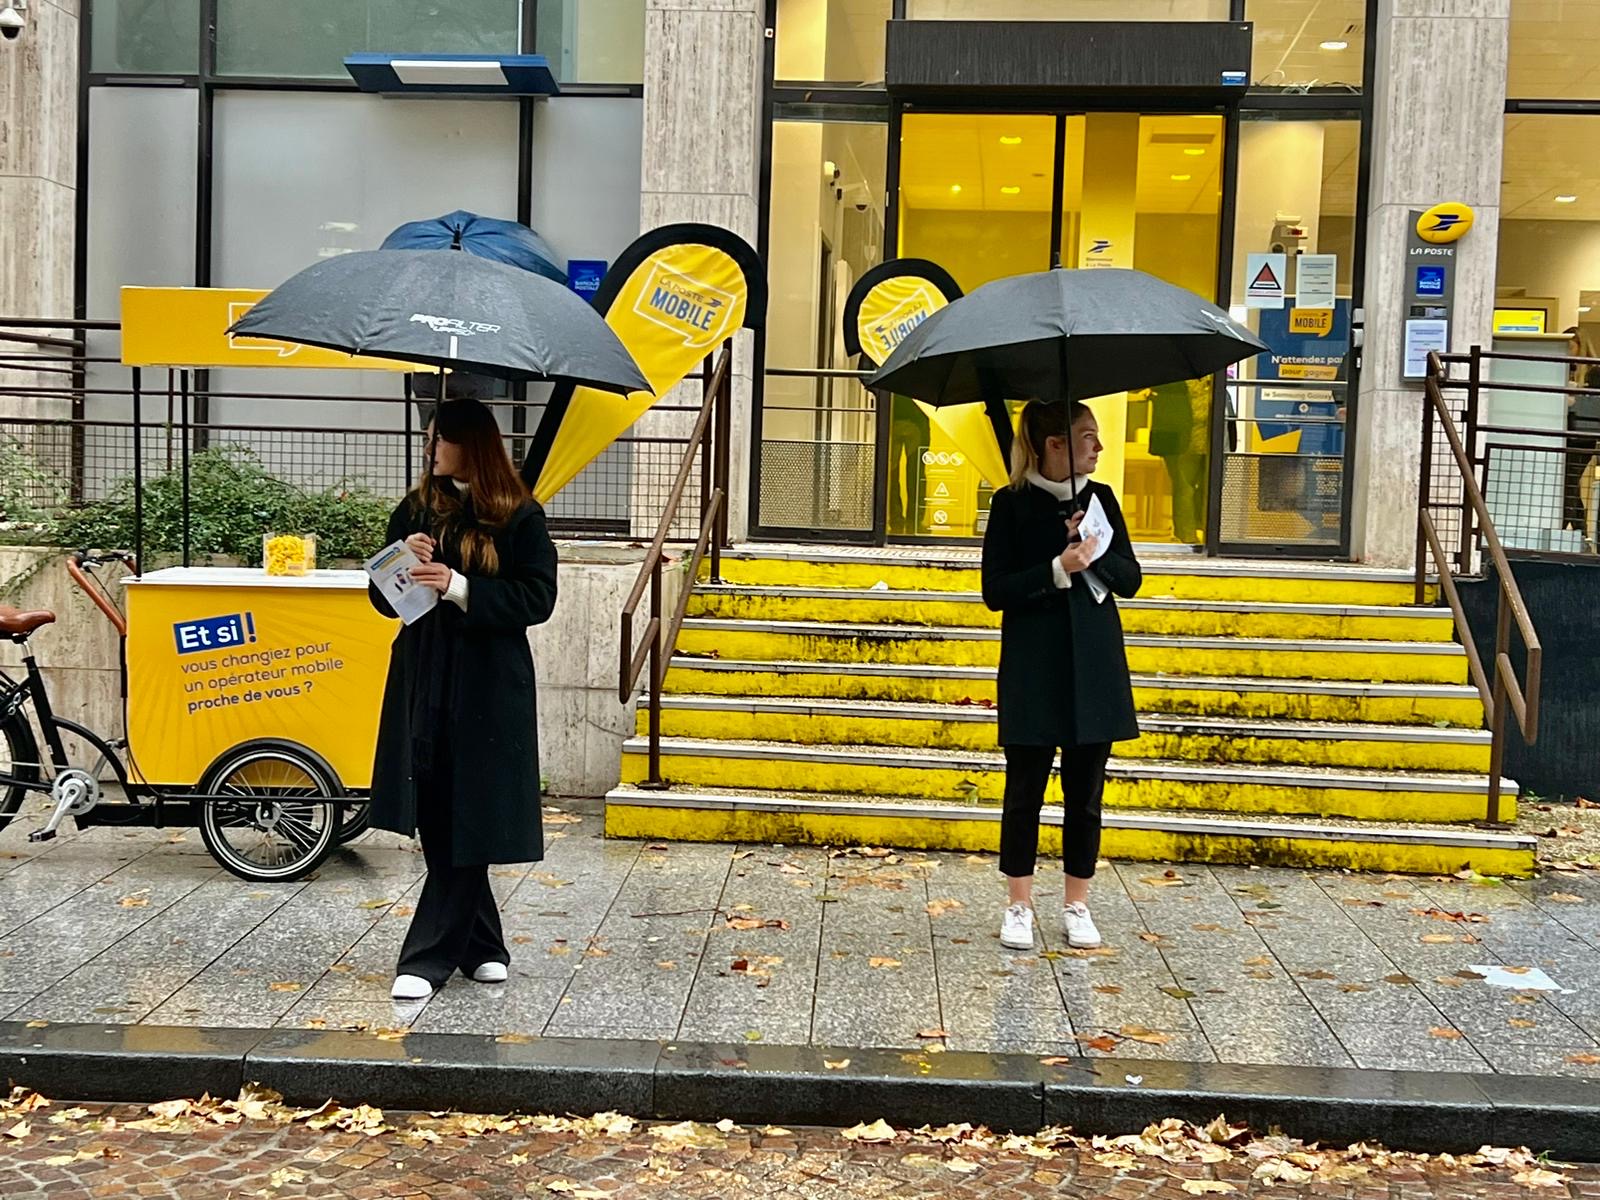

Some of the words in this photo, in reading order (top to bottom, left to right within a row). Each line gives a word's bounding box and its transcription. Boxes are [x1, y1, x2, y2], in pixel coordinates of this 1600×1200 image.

[1410, 247, 1423, 255] LA
[1423, 247, 1455, 256] POSTE
[659, 275, 672, 288] LA
[672, 284, 704, 303] POSTE
[1271, 355, 1326, 364] N'attendez
[179, 625, 212, 649] Et
[216, 619, 239, 643] si
[181, 659, 217, 674] vous
[221, 648, 291, 668] changiez
[295, 641, 331, 658] pour
[184, 680, 204, 693] un
[208, 667, 287, 691] opérateur
[291, 657, 344, 676] mobile
[187, 691, 239, 714] proche
[243, 690, 262, 703] de
[265, 685, 300, 699] vous
